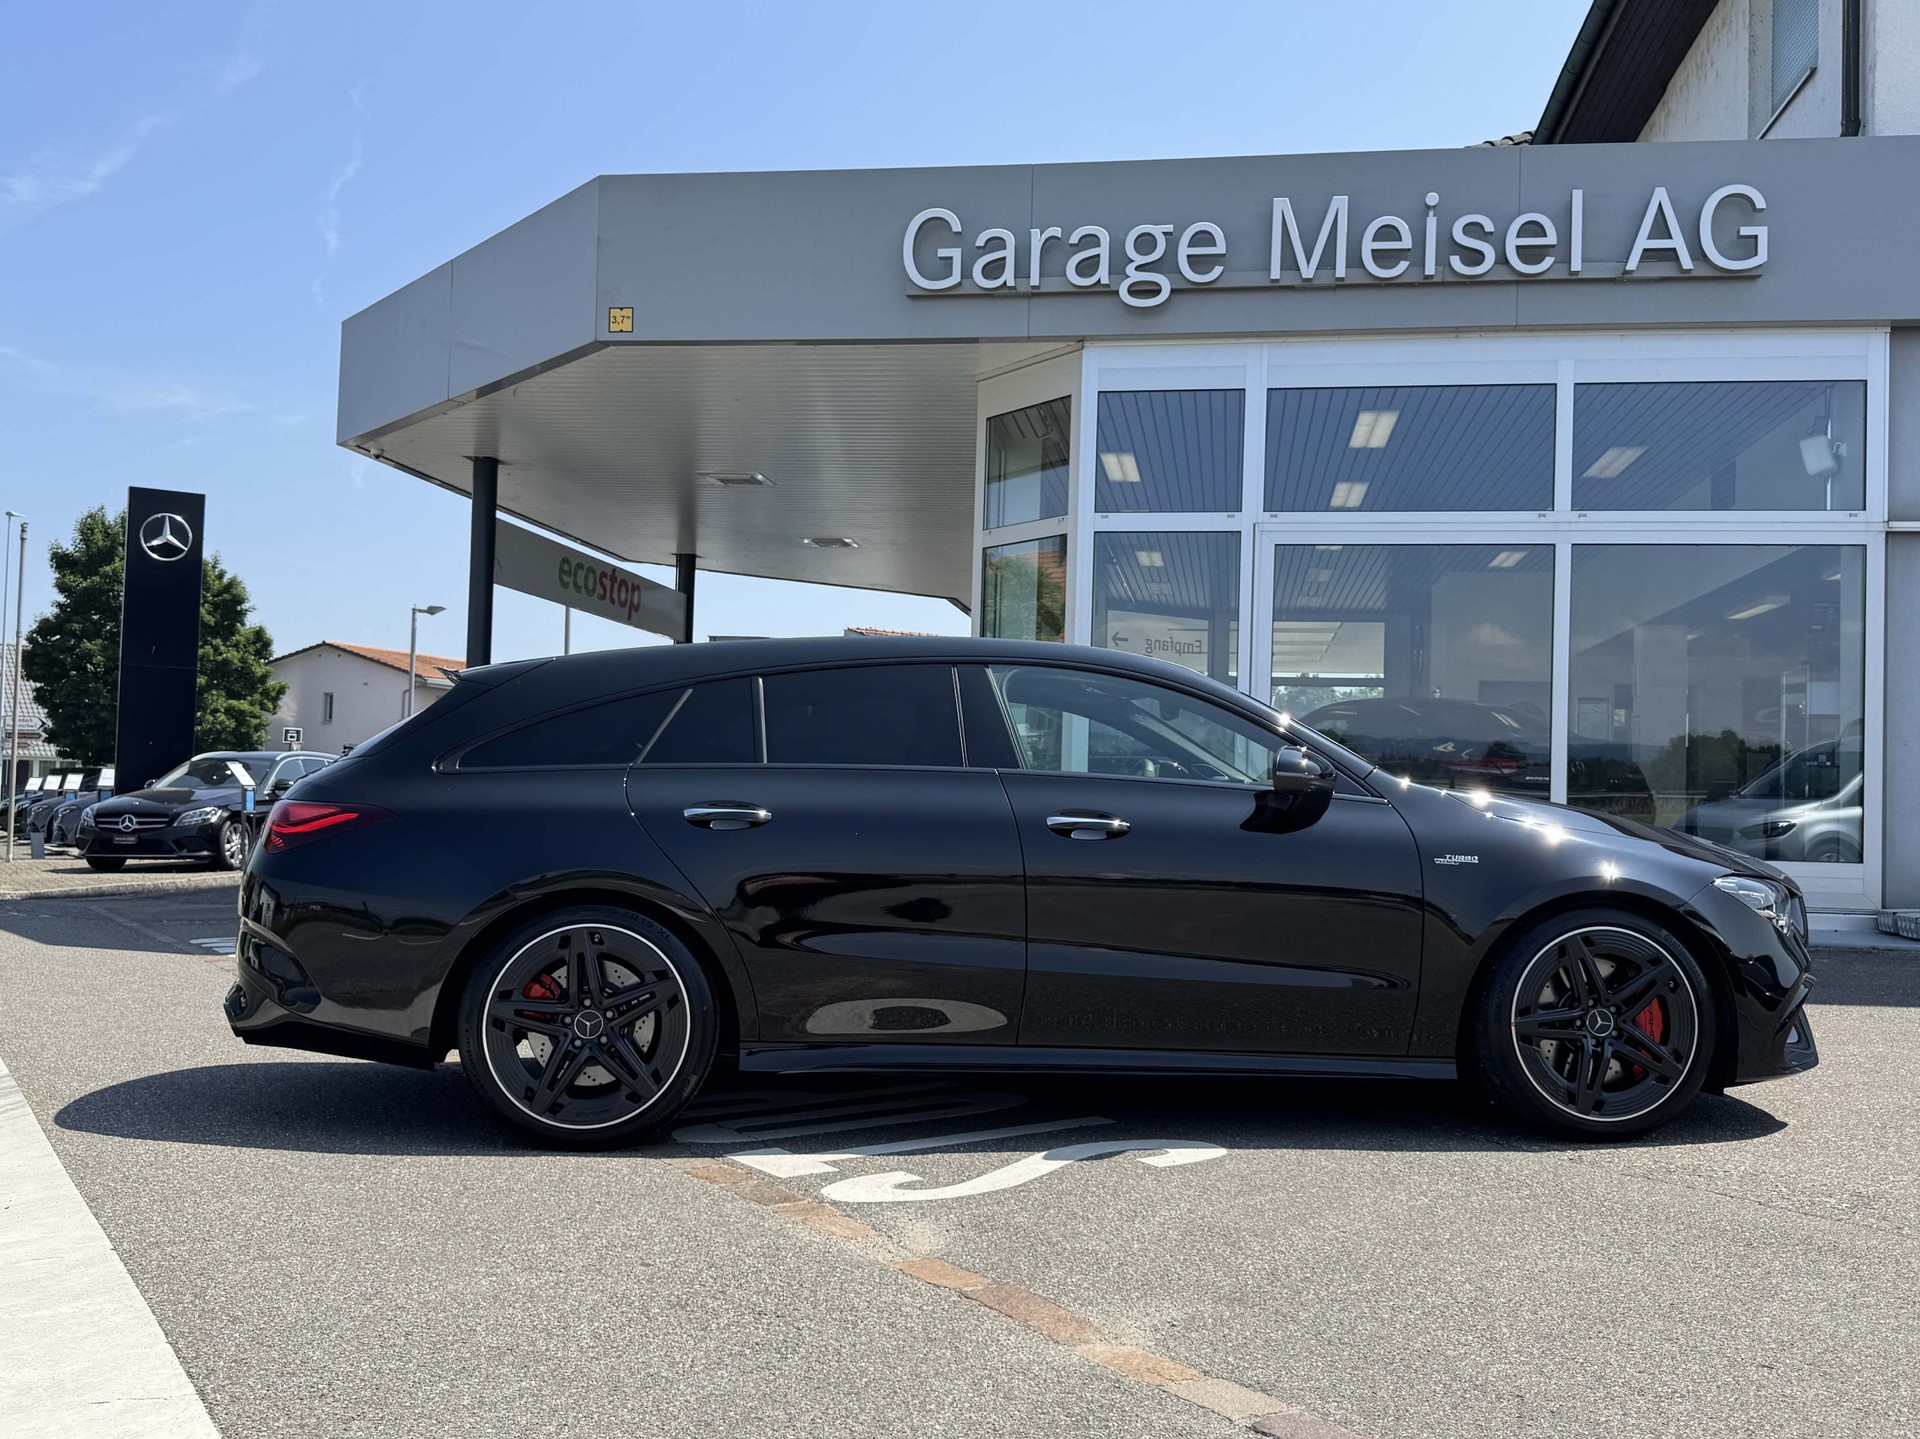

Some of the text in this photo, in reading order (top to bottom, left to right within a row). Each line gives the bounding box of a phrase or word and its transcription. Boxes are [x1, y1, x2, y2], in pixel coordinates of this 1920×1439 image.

[902, 183, 1770, 308] Garage Meisel AG
[558, 556, 641, 621] ecostop
[1444, 854, 1479, 862] TURBO
[1662, 932, 1701, 979] Continental
